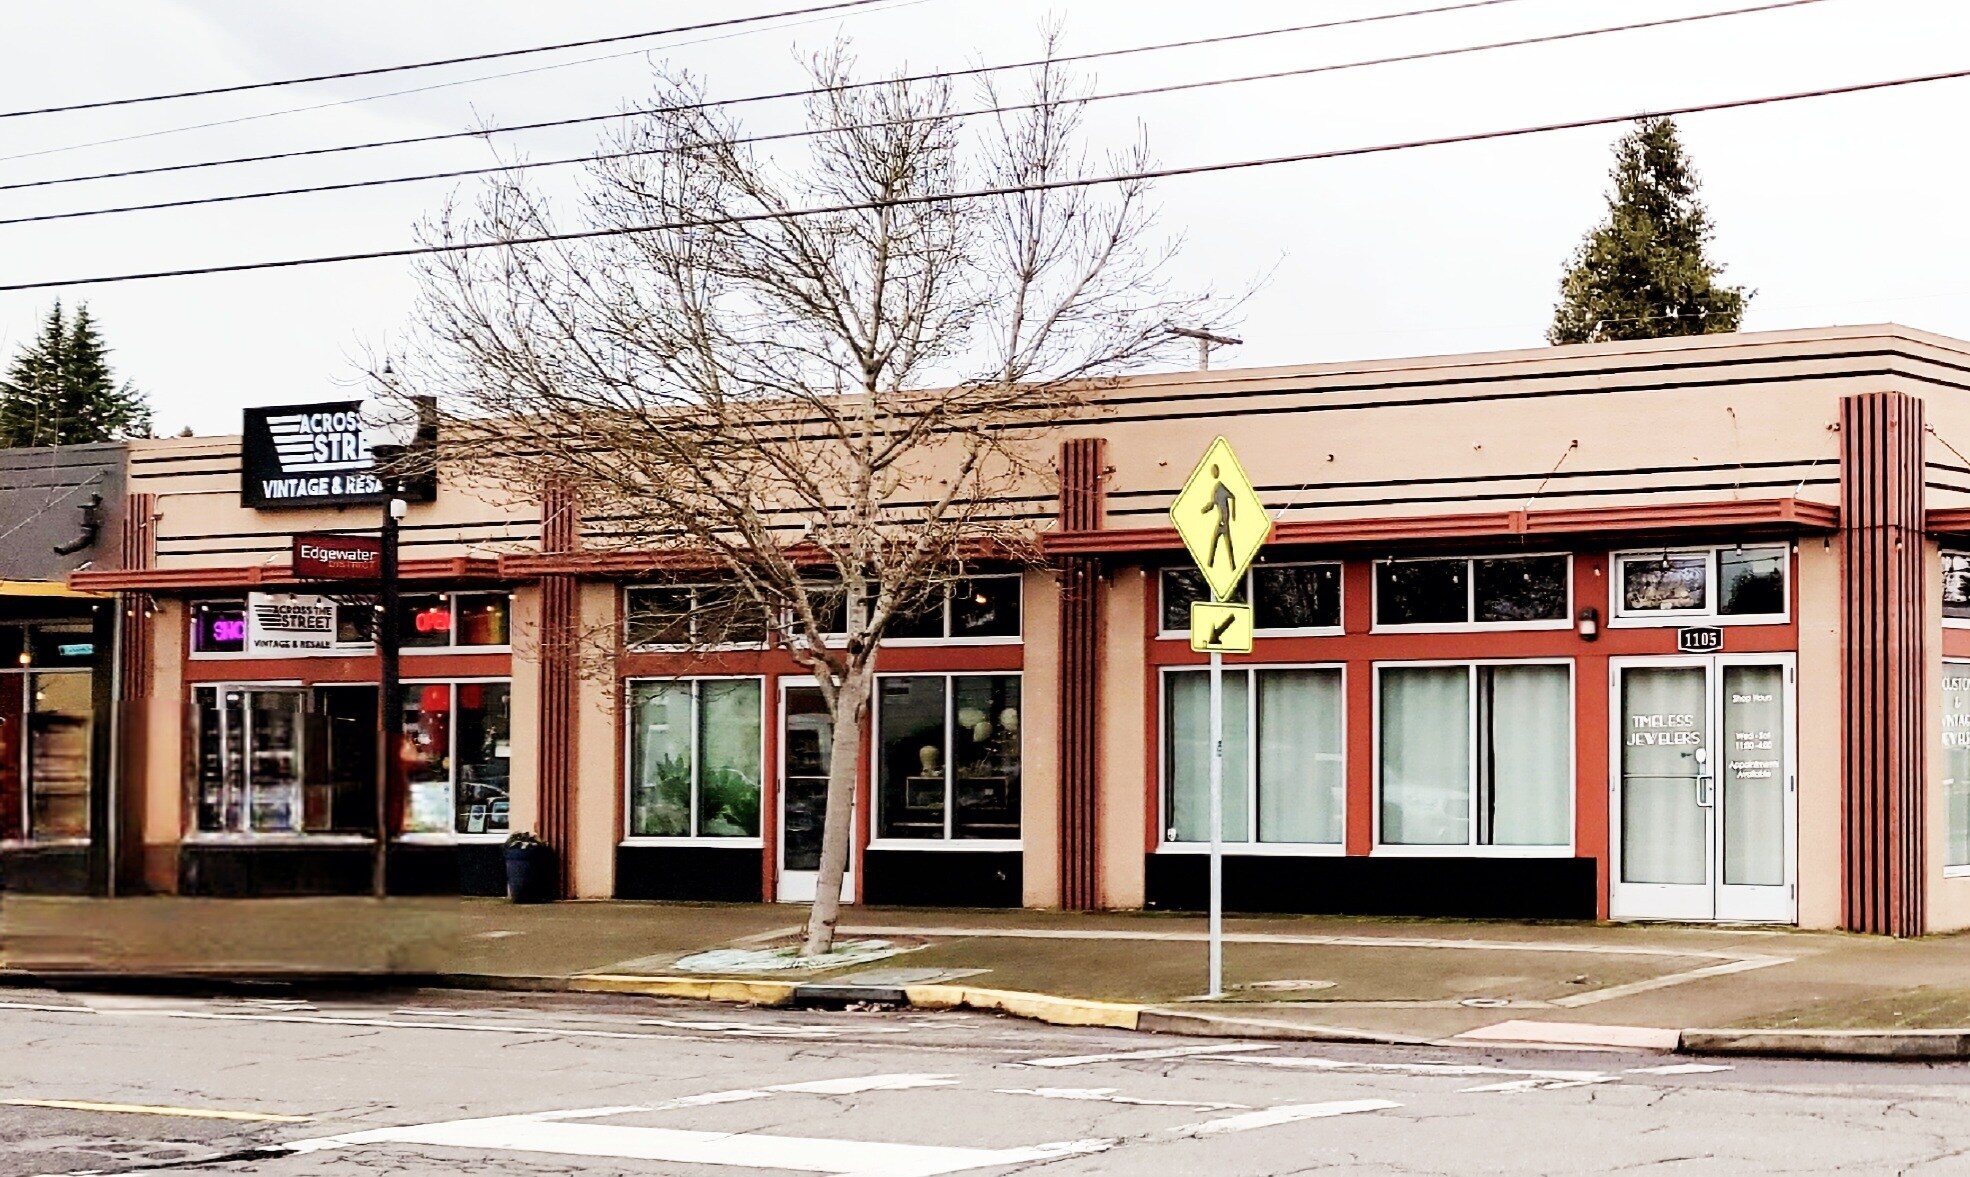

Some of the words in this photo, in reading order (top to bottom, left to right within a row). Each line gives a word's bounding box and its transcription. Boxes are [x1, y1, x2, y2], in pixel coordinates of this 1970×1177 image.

[313, 430, 374, 463] STRE
[262, 477, 329, 499] VINTAGE
[331, 475, 344, 495] &
[346, 474, 405, 495] RESA
[301, 544, 380, 562] Edgewater
[272, 604, 313, 615] ACROSS
[314, 605, 333, 616] THE
[281, 615, 333, 629] STREET
[254, 639, 291, 649] VINTAGE
[292, 640, 299, 649] &
[300, 640, 332, 650] RESALE
[1685, 632, 1717, 647] 1105
[1941, 676, 1970, 691] CUSTO
[1626, 732, 1701, 746] JEWELERS
